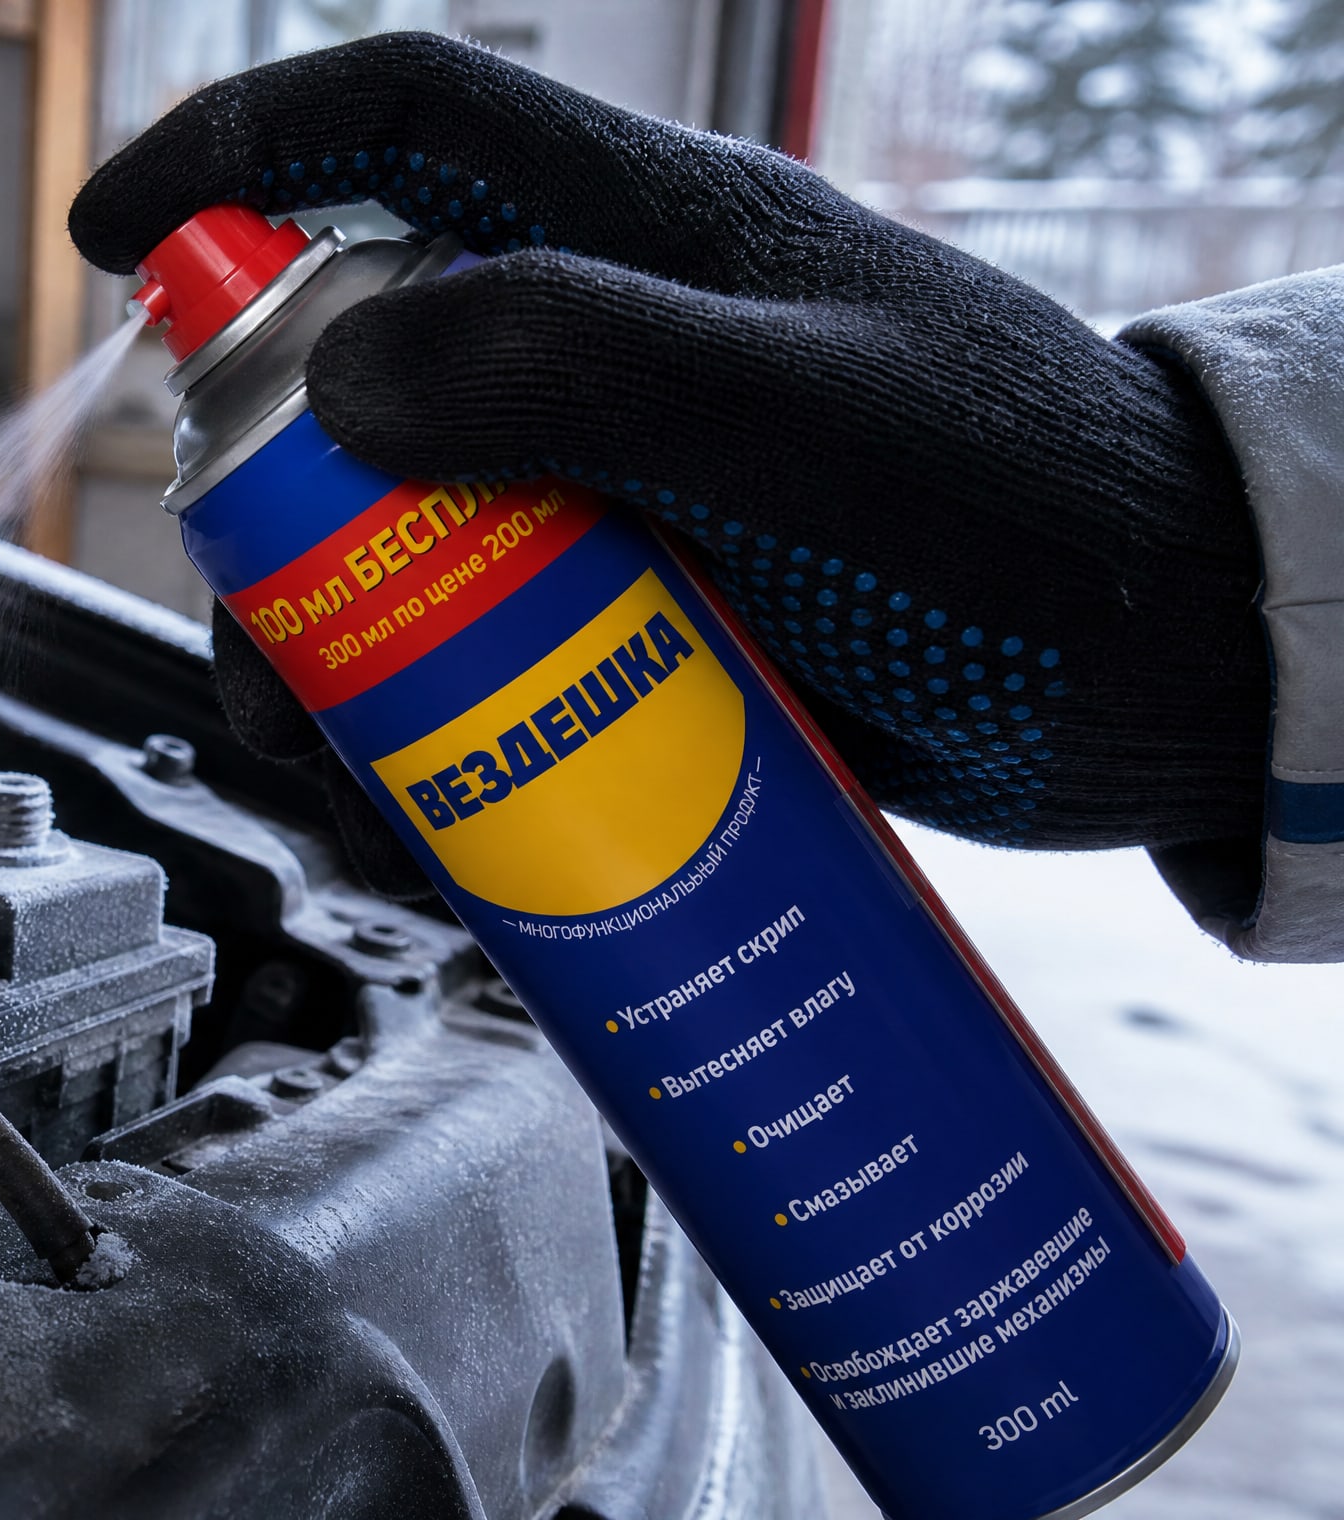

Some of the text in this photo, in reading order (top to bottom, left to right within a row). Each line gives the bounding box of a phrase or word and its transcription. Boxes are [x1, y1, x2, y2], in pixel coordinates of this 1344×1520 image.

[251, 597, 305, 645] 100
[299, 575, 356, 626] мл
[317, 487, 567, 672] 300 мл по цене 200 мл
[406, 610, 695, 832] ВЕЗДЕШКА
[719, 771, 762, 848] ПРОДУКТ
[616, 904, 806, 1030] Устраняет скрип
[661, 970, 856, 1098] Вытесняет влагу
[747, 1074, 854, 1148] Очищает
[778, 1151, 1029, 1311] Защищает от коррозии
[788, 1134, 919, 1222] Смазывает
[809, 1207, 1093, 1383] Освобождает заржавевшие
[829, 1235, 1111, 1411] и заклинившие механизмы
[977, 1380, 1080, 1450] 300 ml
